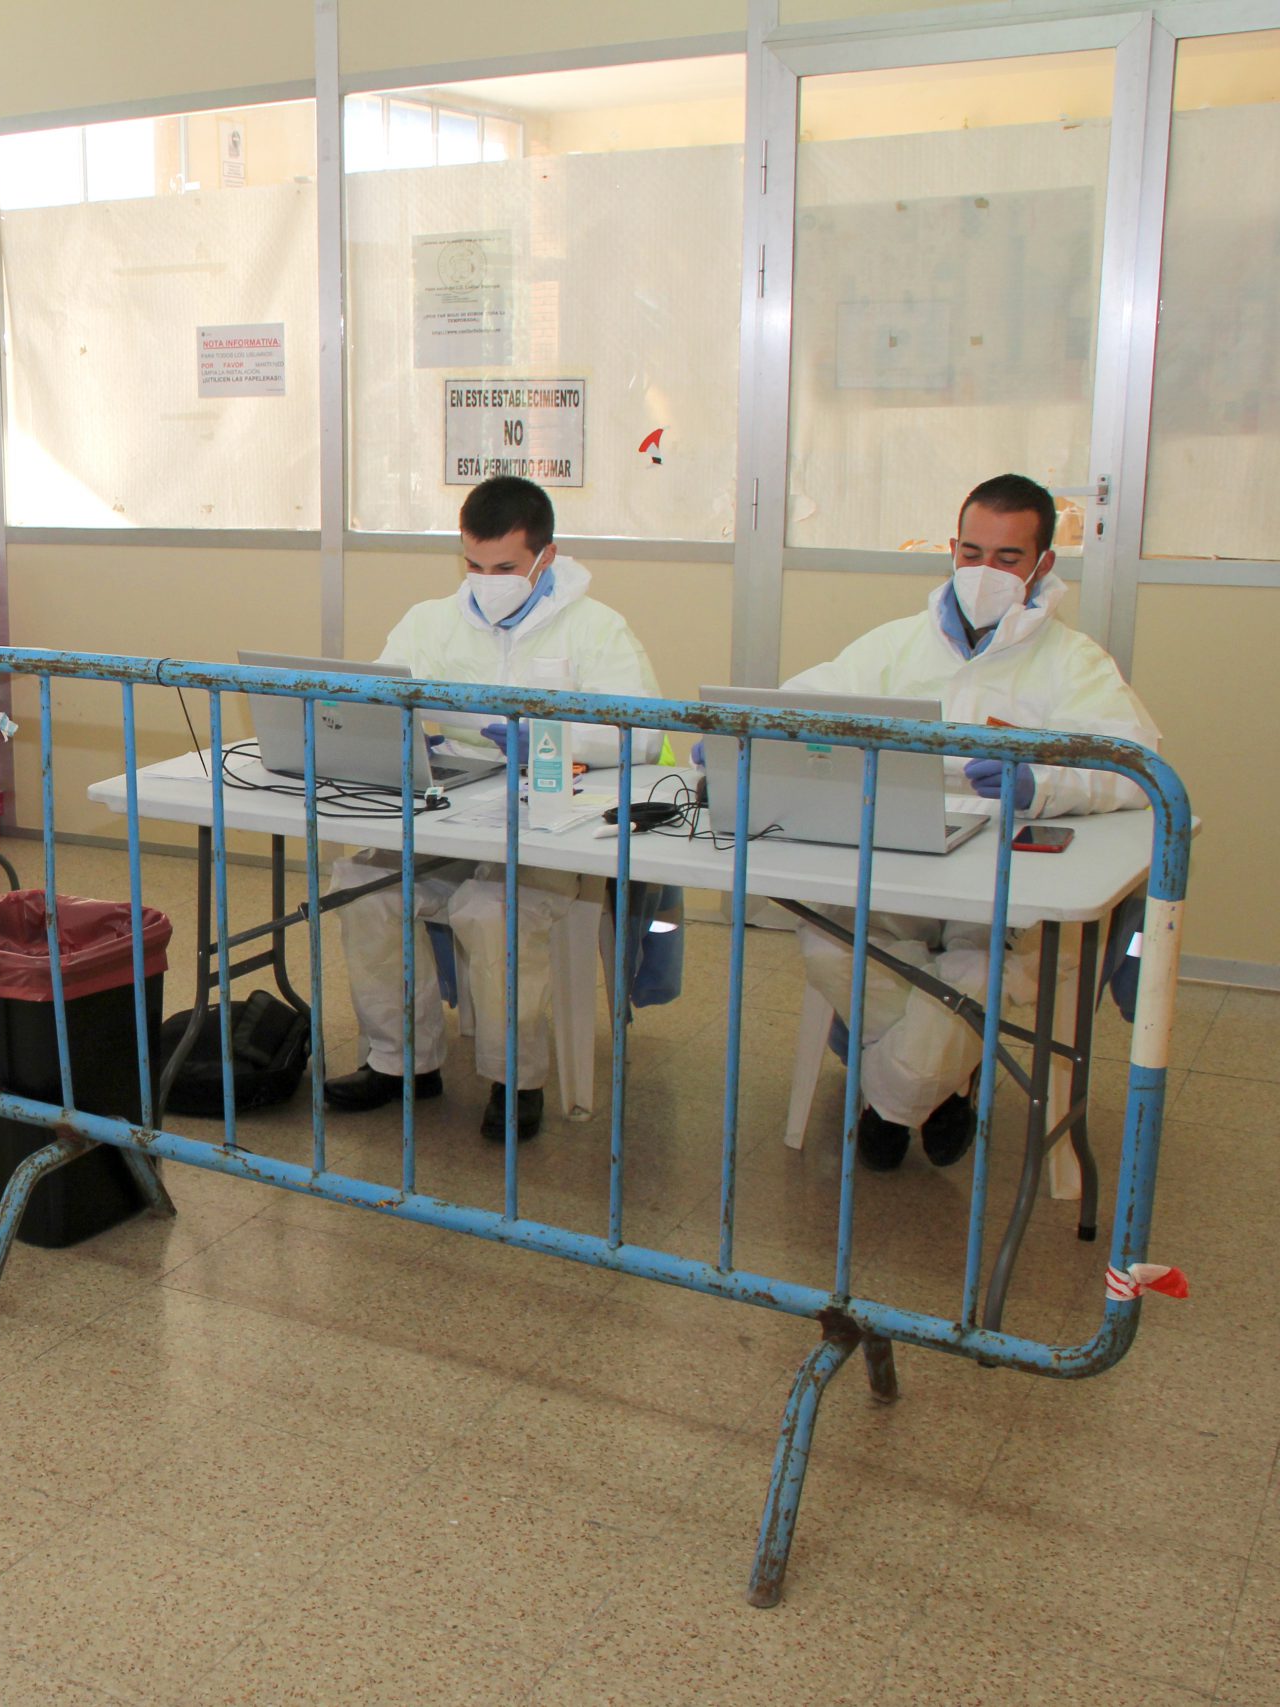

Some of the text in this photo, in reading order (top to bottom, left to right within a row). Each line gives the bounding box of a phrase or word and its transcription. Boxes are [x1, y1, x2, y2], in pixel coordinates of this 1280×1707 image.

[203, 340, 224, 349] NOTA
[450, 389, 580, 408] EN ESTE ESTABLECIMIENTO
[504, 420, 524, 446] NO
[457, 454, 571, 477] ESTÁ PERMITIDO FUMAR
